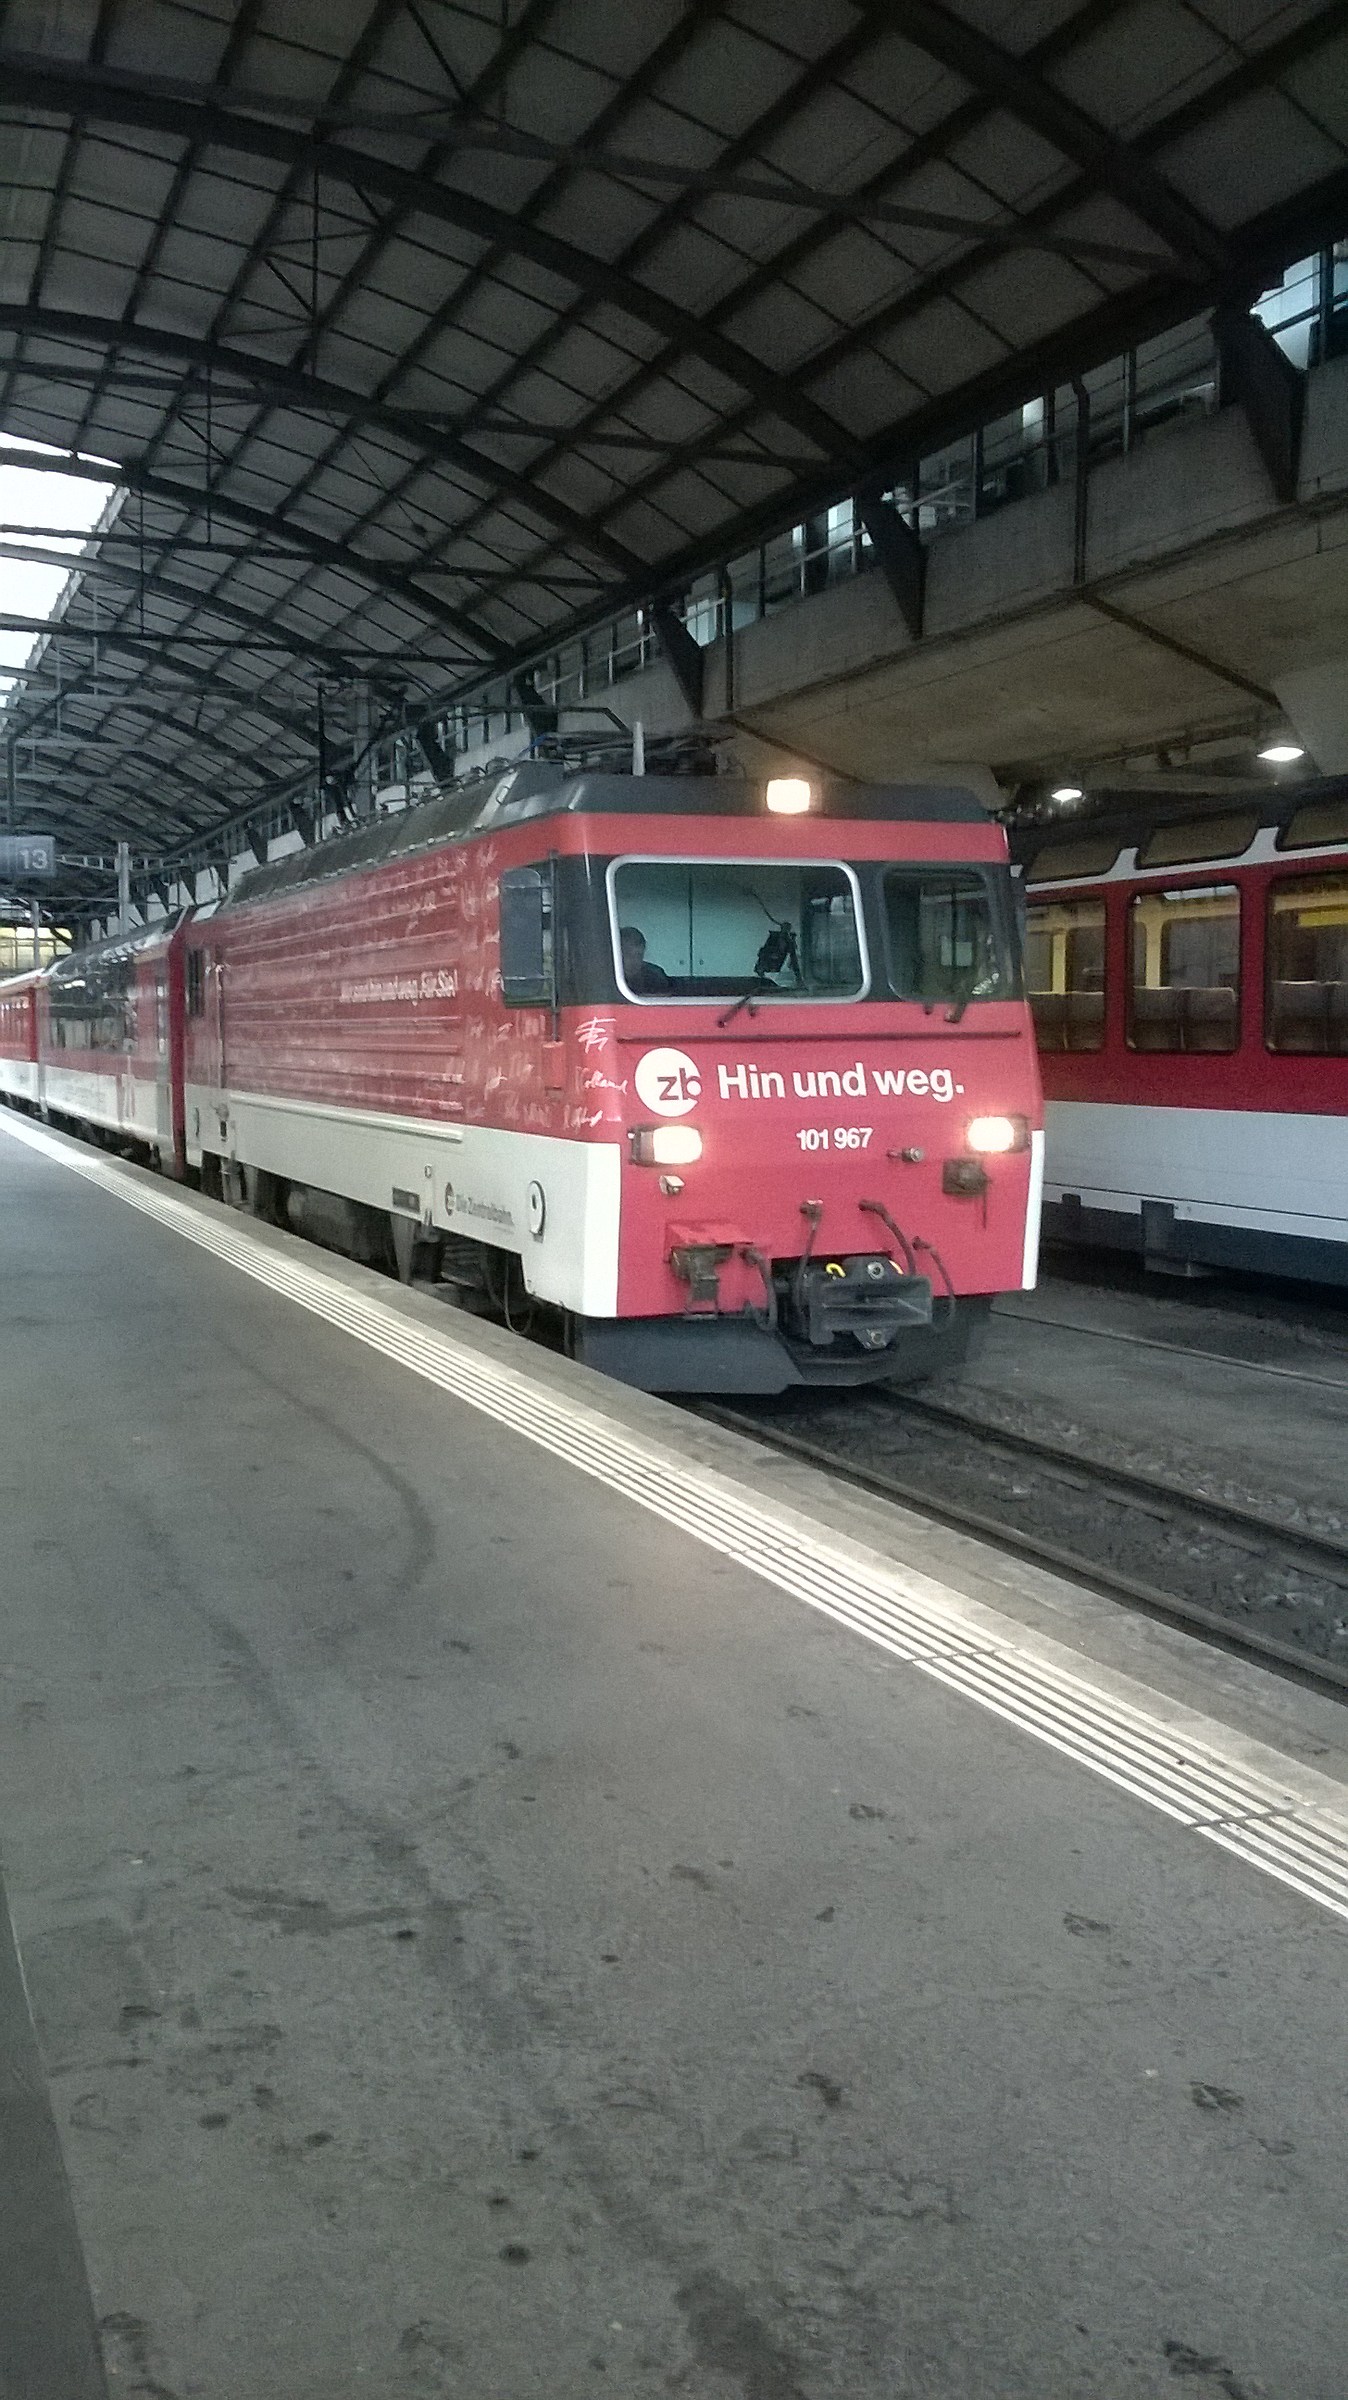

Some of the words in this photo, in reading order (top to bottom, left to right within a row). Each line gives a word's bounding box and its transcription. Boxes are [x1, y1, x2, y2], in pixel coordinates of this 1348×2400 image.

[19, 849, 48, 869] 13
[657, 1068, 701, 1101] zb
[717, 1063, 786, 1099] Hin
[792, 1062, 867, 1098] und
[872, 1066, 965, 1102] weg.
[797, 1130, 830, 1150] 101
[834, 1127, 874, 1148] 967
